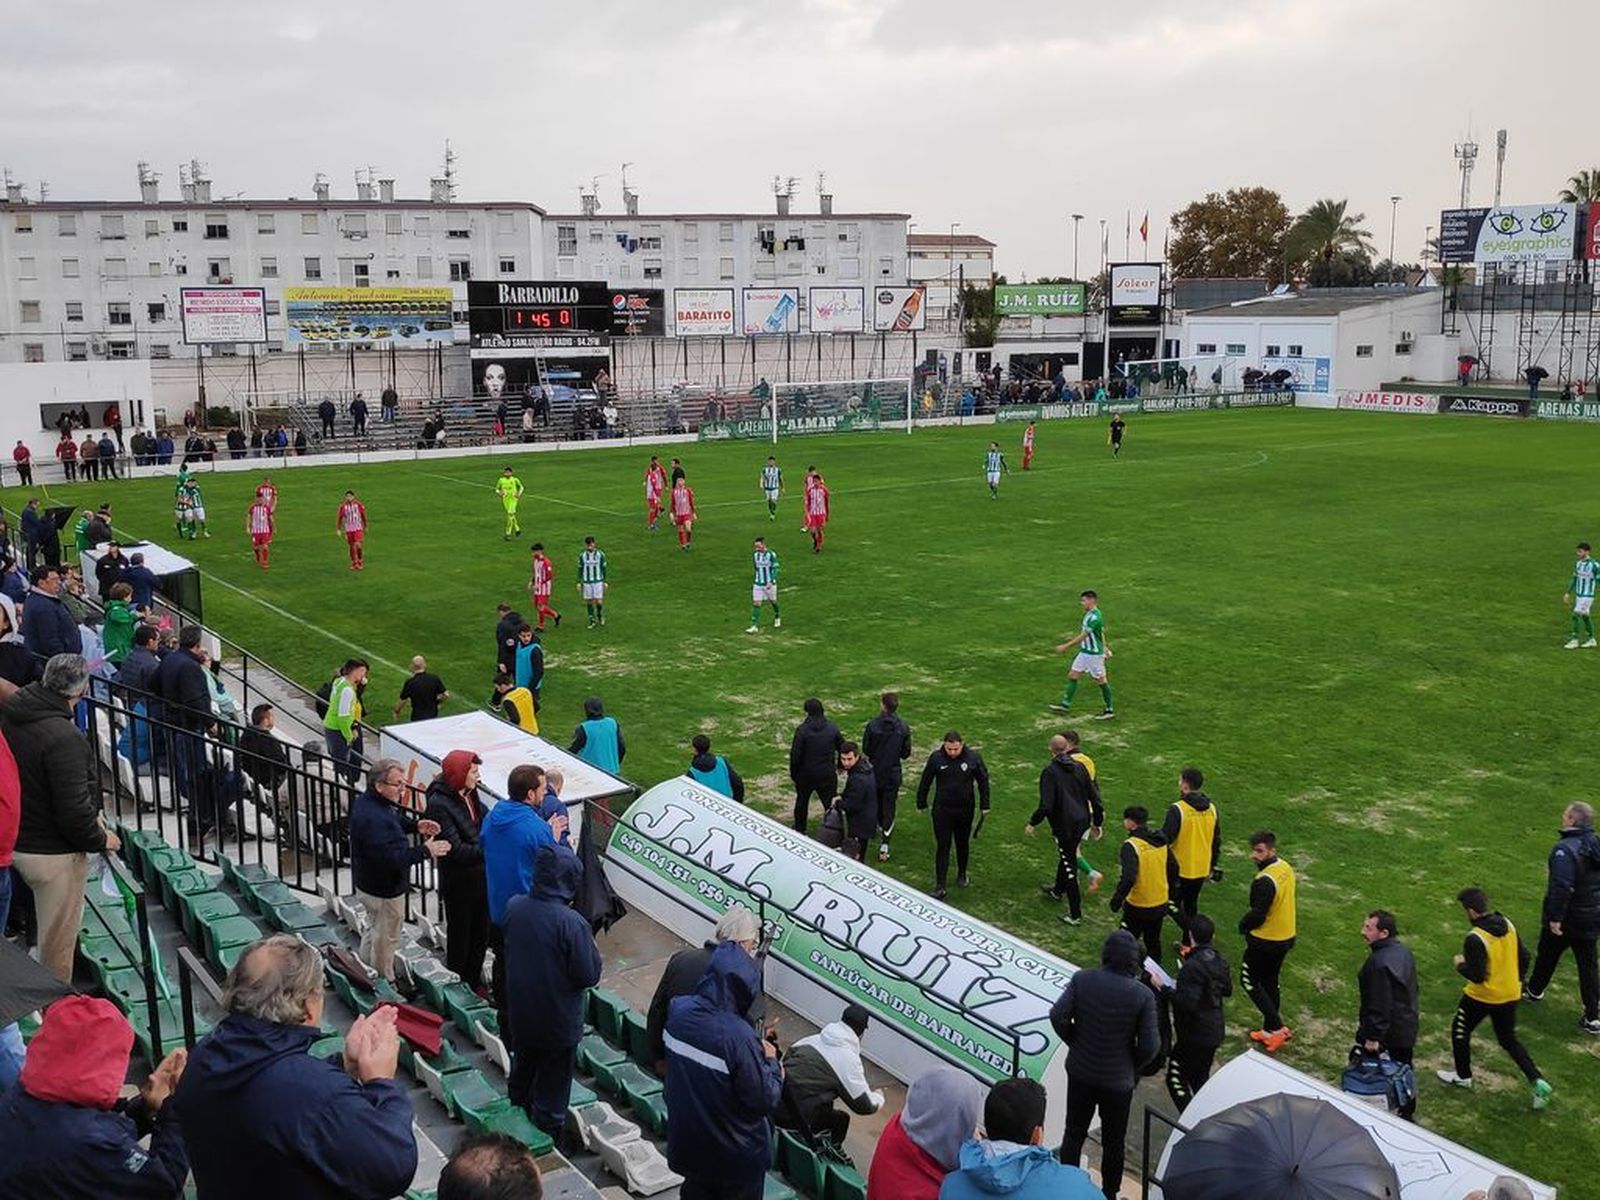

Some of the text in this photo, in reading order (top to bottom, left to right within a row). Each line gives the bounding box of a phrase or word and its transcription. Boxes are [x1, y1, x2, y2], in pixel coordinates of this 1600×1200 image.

[1482, 235, 1572, 254] eyesgraphics
[1116, 278, 1156, 288] Solear
[498, 283, 580, 304] BARBADILLO
[999, 290, 1080, 306] J.M. RUÍZ
[515, 310, 570, 327] 1 45 0
[677, 310, 732, 321] BARATITO
[554, 337, 573, 346] RADIO
[1354, 393, 1425, 407] JMEDIS
[1468, 399, 1519, 413] Kappa
[1537, 401, 1581, 417] ARENAS
[738, 419, 774, 434] CATERIN
[620, 832, 644, 854] 649
[643, 846, 667, 869] 104
[665, 859, 691, 883] 151
[698, 879, 725, 905] 956
[681, 789, 819, 861] CONSTRUCCIONES
[845, 873, 937, 922] GENERAL
[934, 915, 958, 929] Y
[951, 926, 1015, 962] OBRA
[1015, 957, 1073, 991] CIVI
[633, 803, 1056, 1056] J.M. RUÍZ
[809, 948, 1029, 1079] SANLÚCAR DE BARRAMEDA
